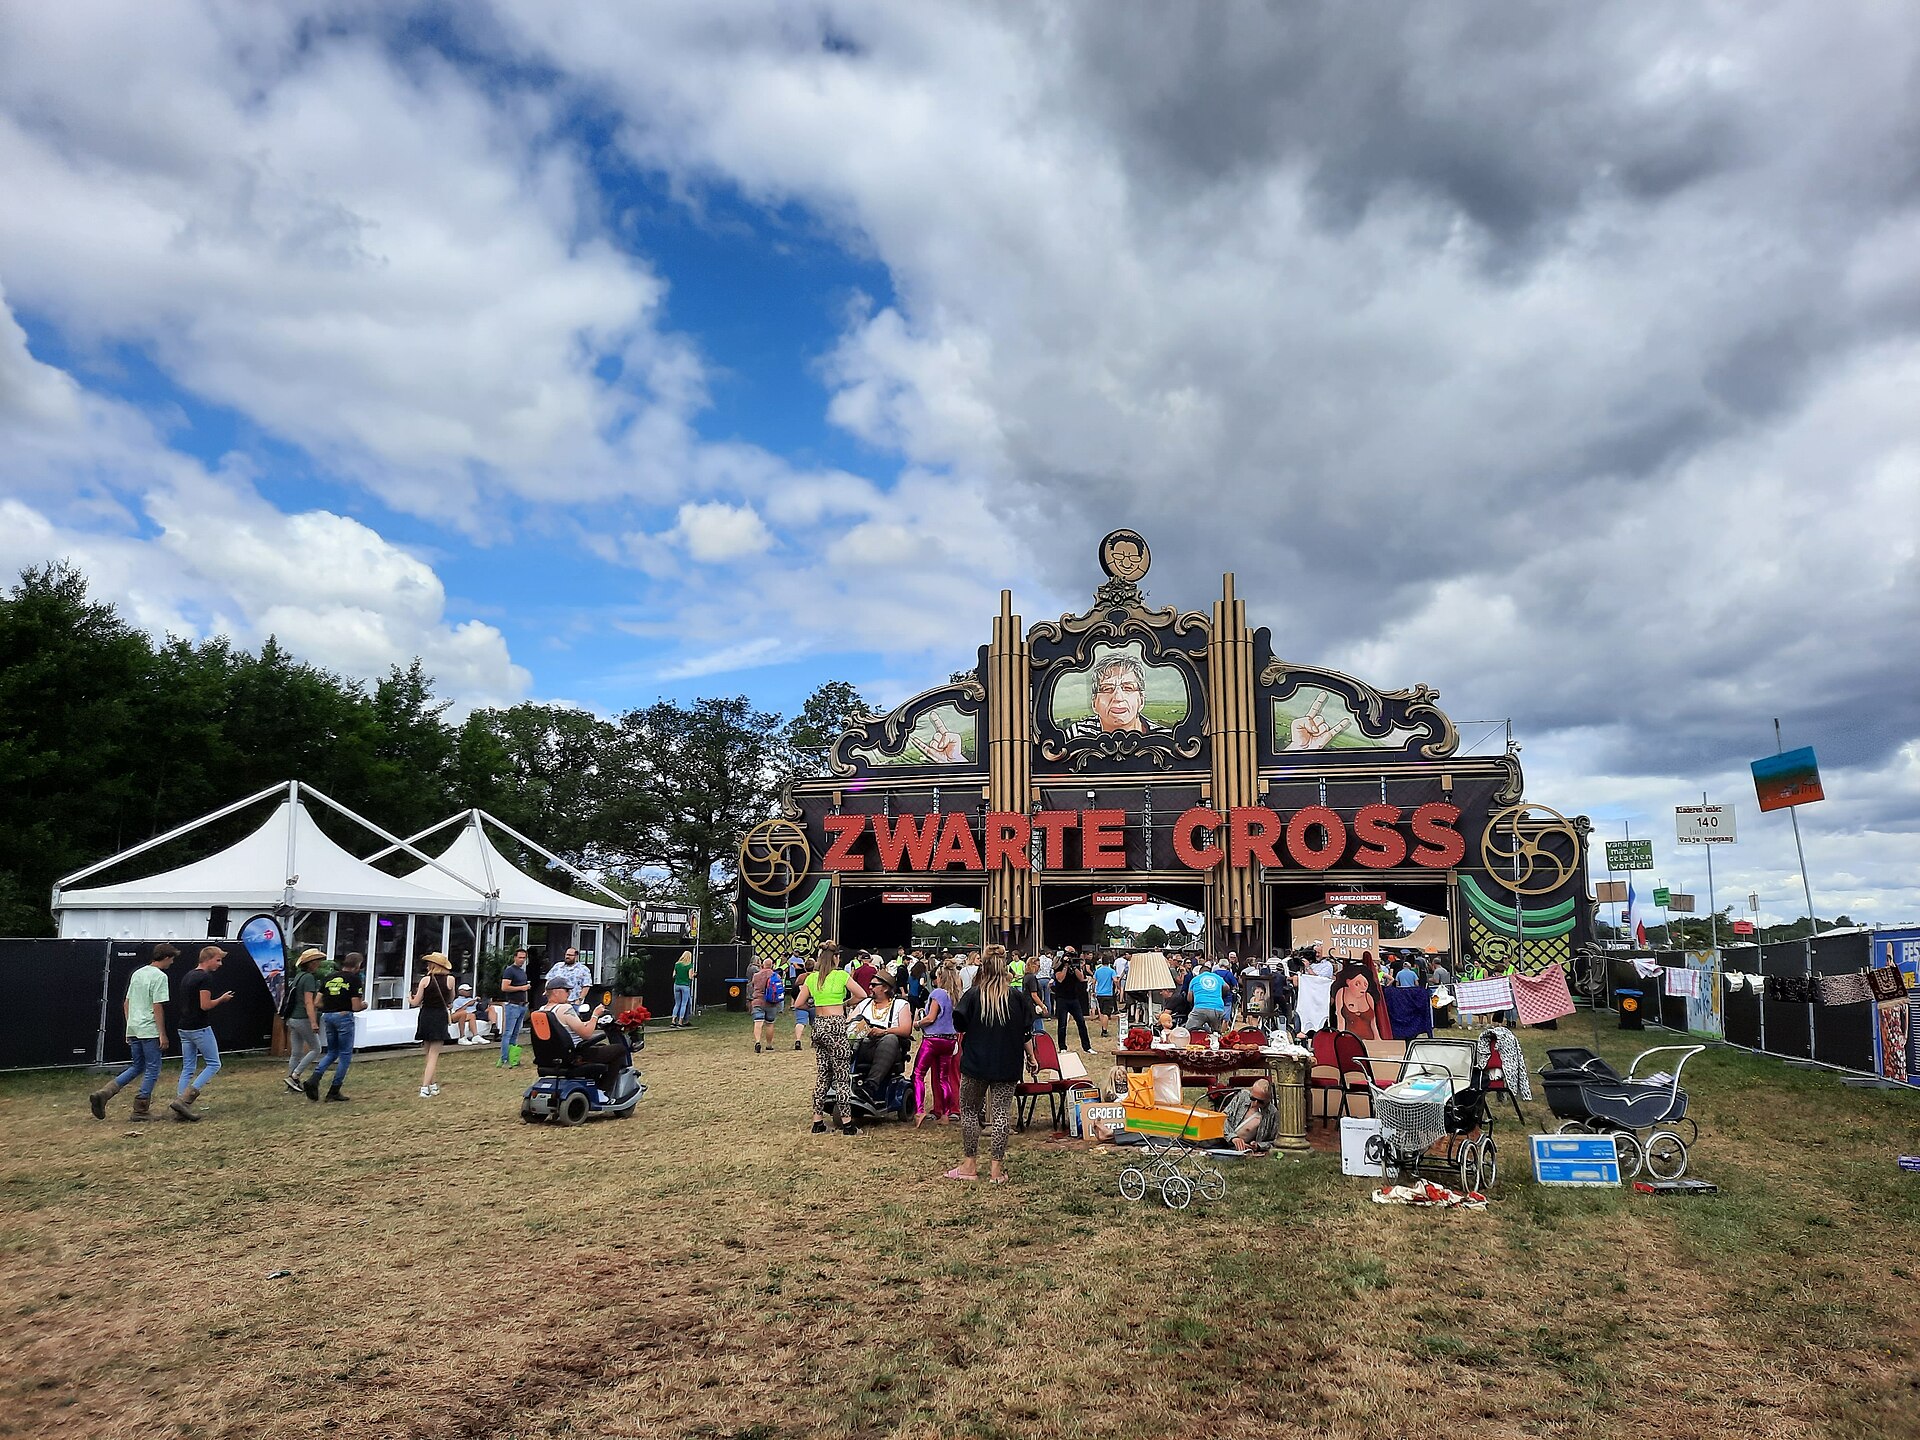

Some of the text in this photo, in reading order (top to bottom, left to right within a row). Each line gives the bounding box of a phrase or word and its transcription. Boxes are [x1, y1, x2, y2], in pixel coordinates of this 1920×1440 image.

[1696, 816, 1718, 828] 140
[823, 801, 1466, 871] ZWARTE CROSS
[1330, 923, 1373, 935] WELKOM
